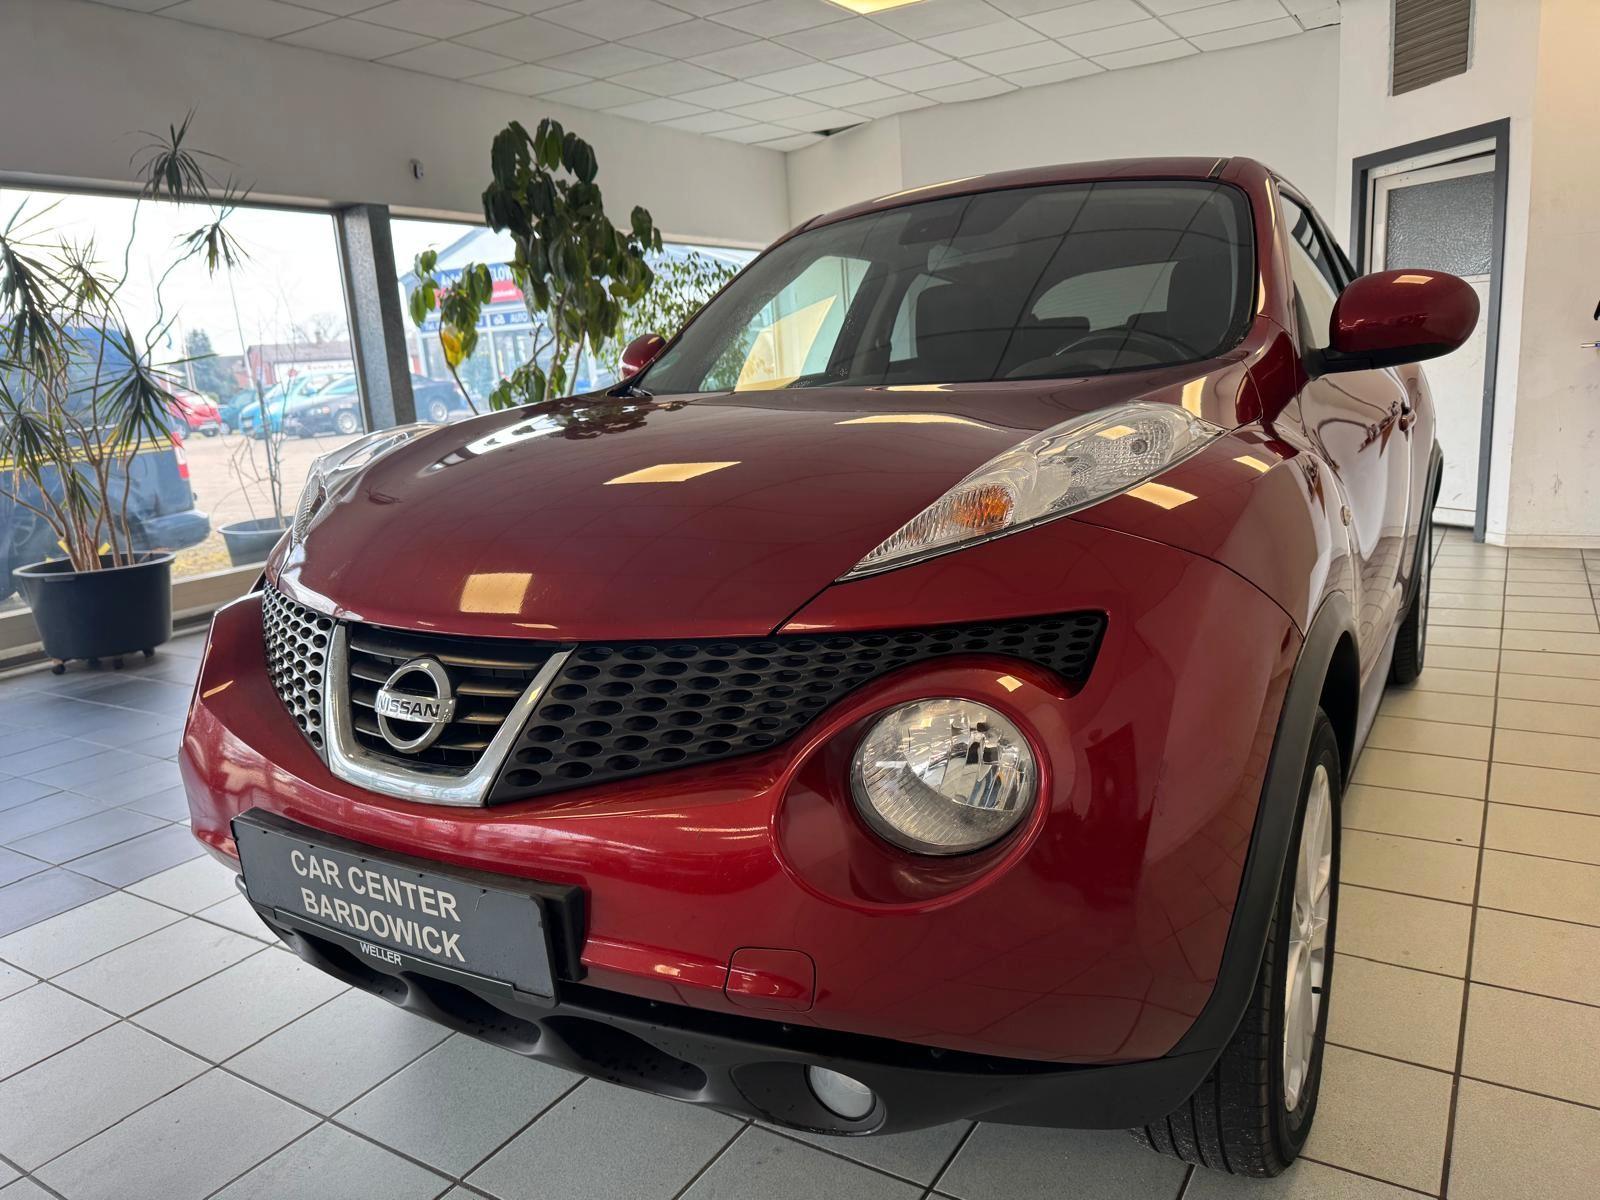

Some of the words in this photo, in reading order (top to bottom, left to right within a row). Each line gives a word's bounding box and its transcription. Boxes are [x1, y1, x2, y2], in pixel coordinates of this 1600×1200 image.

[376, 695, 440, 718] NISSAN
[290, 849, 344, 889] CAR
[347, 866, 461, 922] CENTER
[300, 887, 466, 963] BARDOWICK
[359, 941, 402, 966] WELLER
